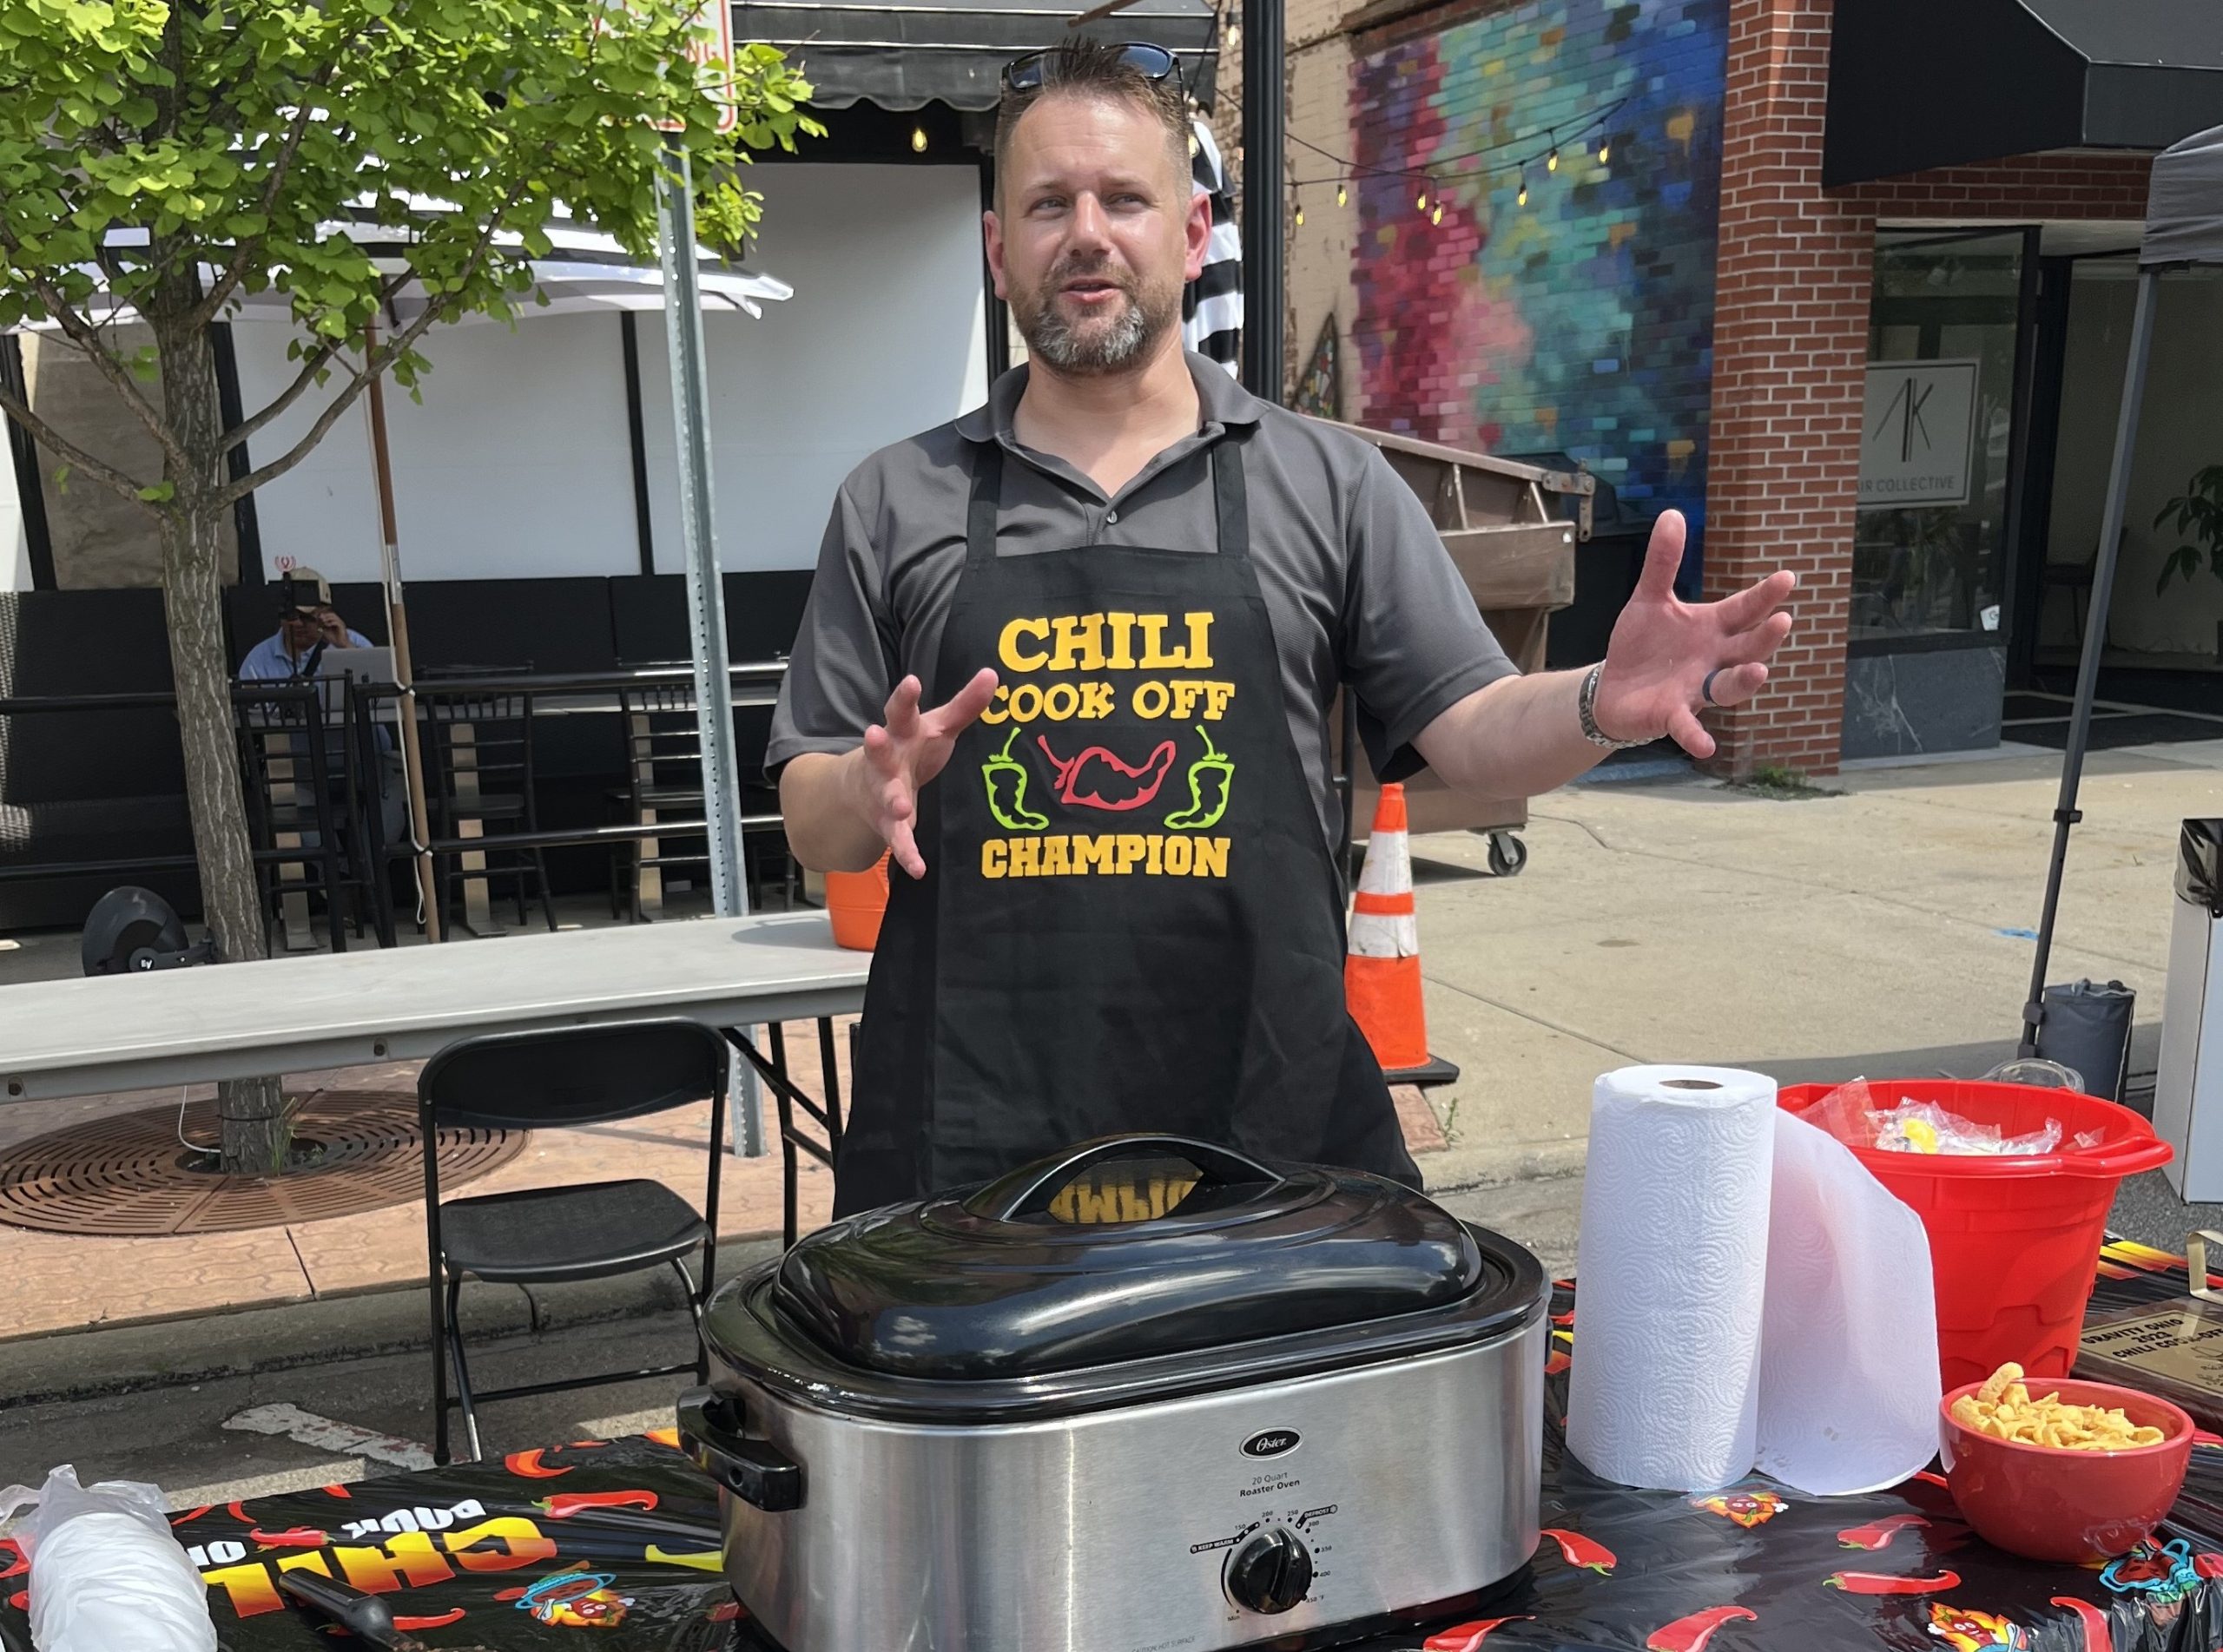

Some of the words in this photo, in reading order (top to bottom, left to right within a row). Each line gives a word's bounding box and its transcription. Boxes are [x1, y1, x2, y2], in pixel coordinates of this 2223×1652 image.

[1877, 477, 1954, 493] COLLECTIVE
[999, 611, 1215, 673] CHILI
[980, 681, 1116, 725] COOK
[1131, 680, 1236, 721] OFF
[981, 834, 1231, 879] CHAMPION
[2081, 1327, 2145, 1345] GRAVITY
[2144, 1319, 2184, 1331] OHIO
[2113, 1345, 2158, 1358] CHILI
[1256, 1437, 1287, 1452] Oster
[1252, 1477, 1263, 1485] 20
[1264, 1472, 1288, 1483] Quart
[1240, 1485, 1275, 1497] Roaster
[1276, 1479, 1300, 1490] Oven
